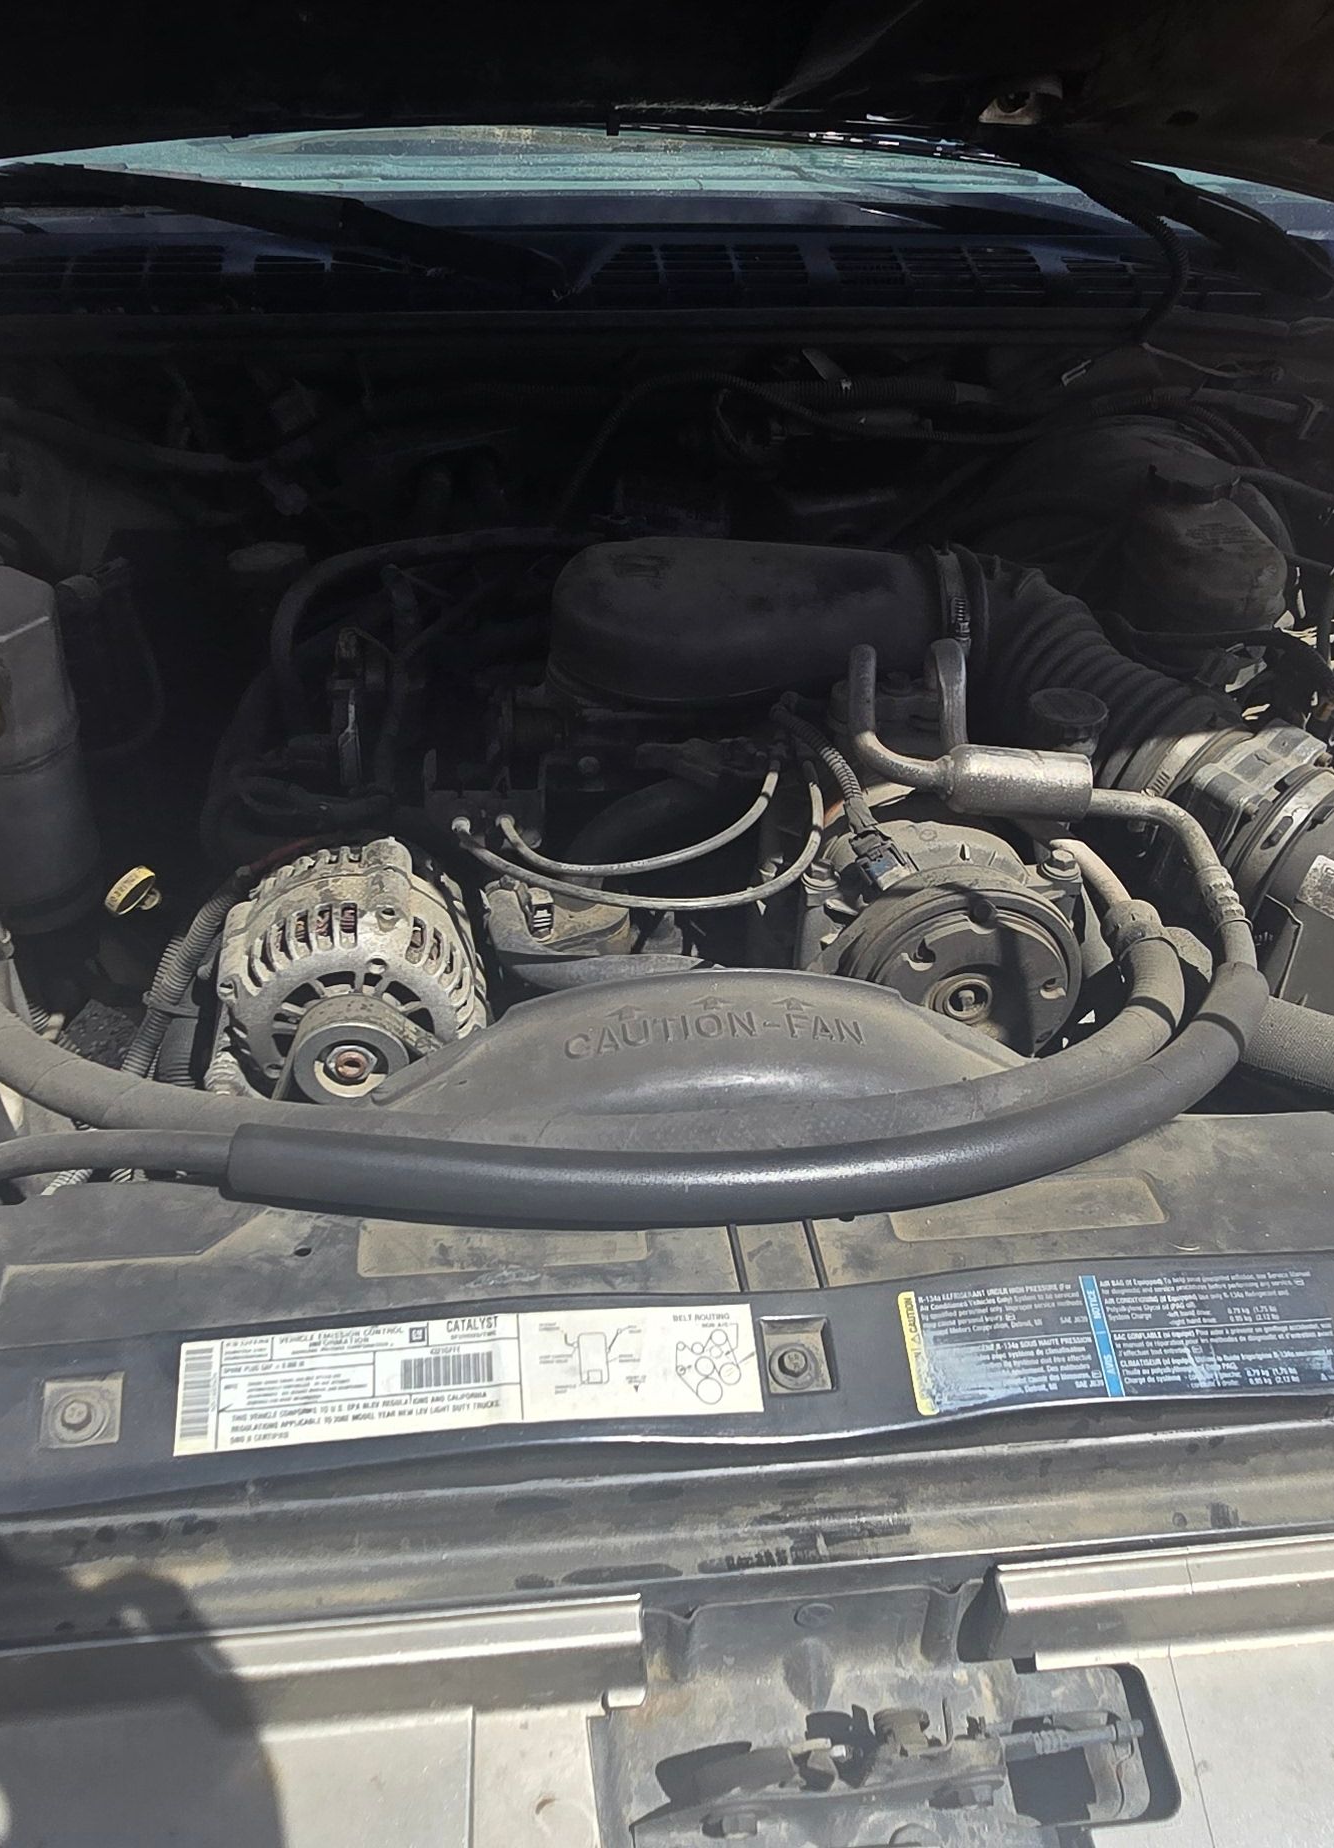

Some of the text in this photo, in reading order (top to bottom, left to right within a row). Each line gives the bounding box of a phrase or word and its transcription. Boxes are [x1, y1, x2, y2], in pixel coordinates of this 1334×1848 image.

[673, 1312, 730, 1322] BELT ROUTING
[904, 1297, 918, 1334] CAUTION
[1087, 1290, 1101, 1320] NOTICE
[279, 1326, 404, 1344] VEHICLE EMISSION CONTROL
[447, 1316, 499, 1333] CATALYST
[309, 1337, 369, 1347] INFORMATION
[231, 1422, 278, 1433] REGULATIONS
[280, 1417, 320, 1428] APPLICABLE
[352, 1411, 374, 1421] MODEL
[378, 1410, 395, 1419] YEAR
[398, 1408, 413, 1417] NEW
[430, 1405, 450, 1414] LIGHT
[452, 1403, 470, 1412] DUTY
[232, 1413, 246, 1422] THIS
[250, 1411, 277, 1420] VEHICLE
[279, 1407, 317, 1418] CONFORMS
[382, 1397, 428, 1407] REGULATIONS
[431, 1394, 444, 1403] AND
[447, 1392, 487, 1402] CALIFORNIA
